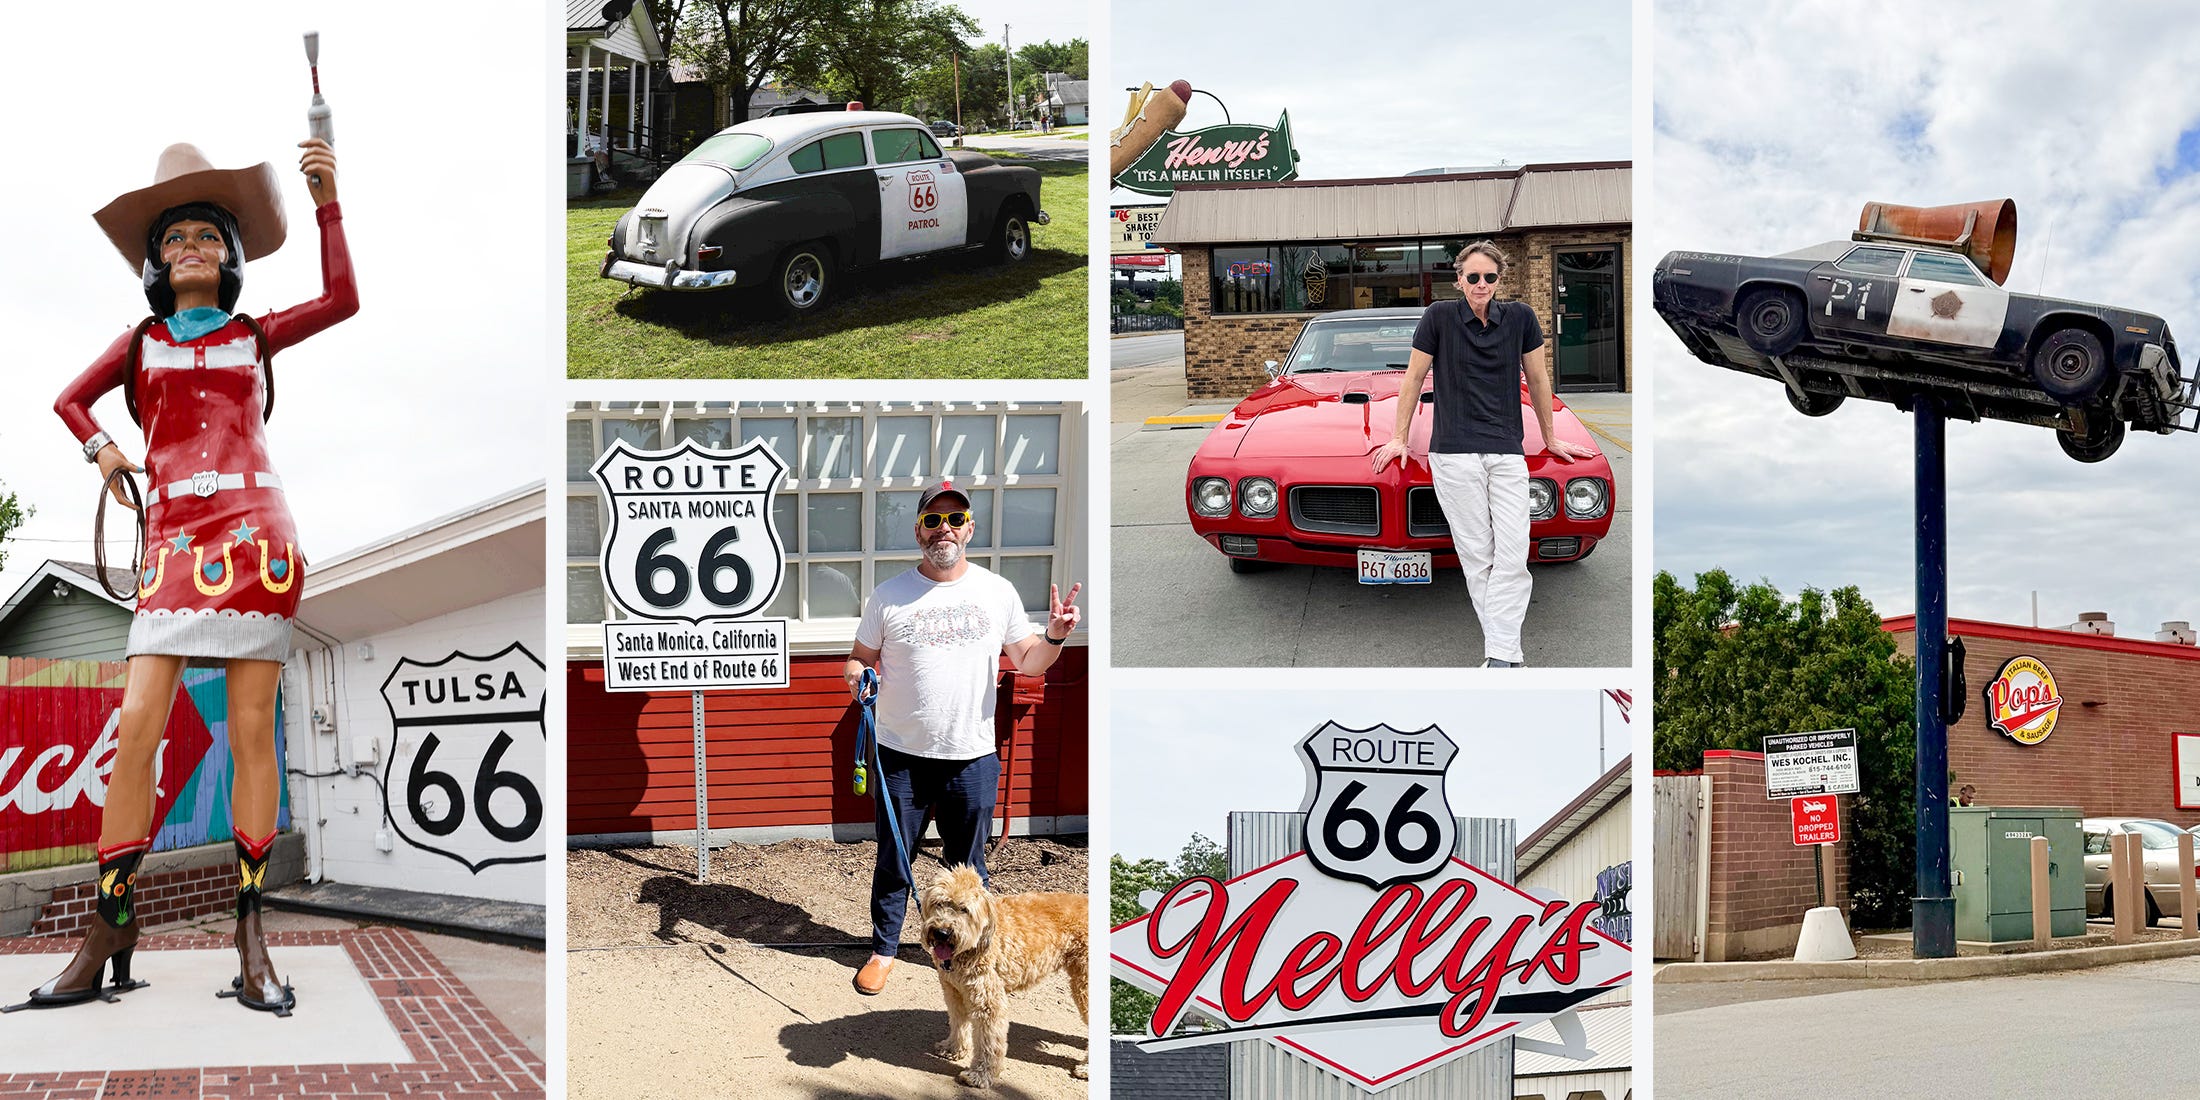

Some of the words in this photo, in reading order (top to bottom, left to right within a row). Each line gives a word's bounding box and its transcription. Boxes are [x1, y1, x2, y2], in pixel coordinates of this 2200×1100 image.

[1164, 132, 1270, 169] Henry's
[1158, 170, 1169, 181] A
[1172, 169, 1205, 181] MEAL
[1208, 168, 1221, 181] IN
[914, 186, 934, 208] 66
[908, 218, 940, 230] PATROL
[1137, 213, 1159, 221] BEST
[1123, 233, 1133, 241] IN
[1139, 232, 1153, 241] TO
[1125, 223, 1159, 232] SHAKES
[1230, 262, 1271, 275] OPEN
[1824, 278, 1872, 320] P1
[624, 464, 756, 490] ROUTE
[197, 481, 215, 494] 66
[627, 501, 682, 519] SANTA
[688, 500, 756, 518] MONICA
[635, 525, 754, 609] 66
[1361, 561, 1386, 579] P67
[1394, 562, 1428, 578] 6836
[915, 615, 979, 633] PTOWN
[616, 633, 653, 652] Santa
[657, 631, 709, 651] Monica,
[712, 629, 777, 650] California
[618, 662, 656, 681] West
[661, 660, 689, 680] End
[694, 660, 709, 679] of
[713, 660, 757, 679] Route
[761, 658, 778, 677] 66
[2007, 661, 2032, 677] ITALIAN
[2032, 664, 2049, 680] BEEF
[402, 671, 527, 706] TULSA
[1990, 677, 2053, 720] Pop's
[2019, 731, 2026, 739] &
[2026, 718, 2053, 740] SAUSAGE
[1768, 737, 1808, 745] UNAUTHORIZED
[1817, 732, 1851, 741] IMPROPERLY
[1786, 743, 1807, 751] PARKED
[1808, 740, 1834, 749] VEHICLES
[1332, 737, 1435, 766] ROUTE
[1771, 758, 1791, 767] WES
[1832, 753, 1851, 762] INC.
[407, 730, 543, 843] 66
[1323, 779, 1441, 864] 66
[1798, 822, 1834, 832] DROPPED
[1810, 814, 1821, 822] NO
[1799, 831, 1835, 841] TRAILERS
[1147, 875, 1602, 1038] Nelly's
[103, 1089, 195, 1097] MARKET
